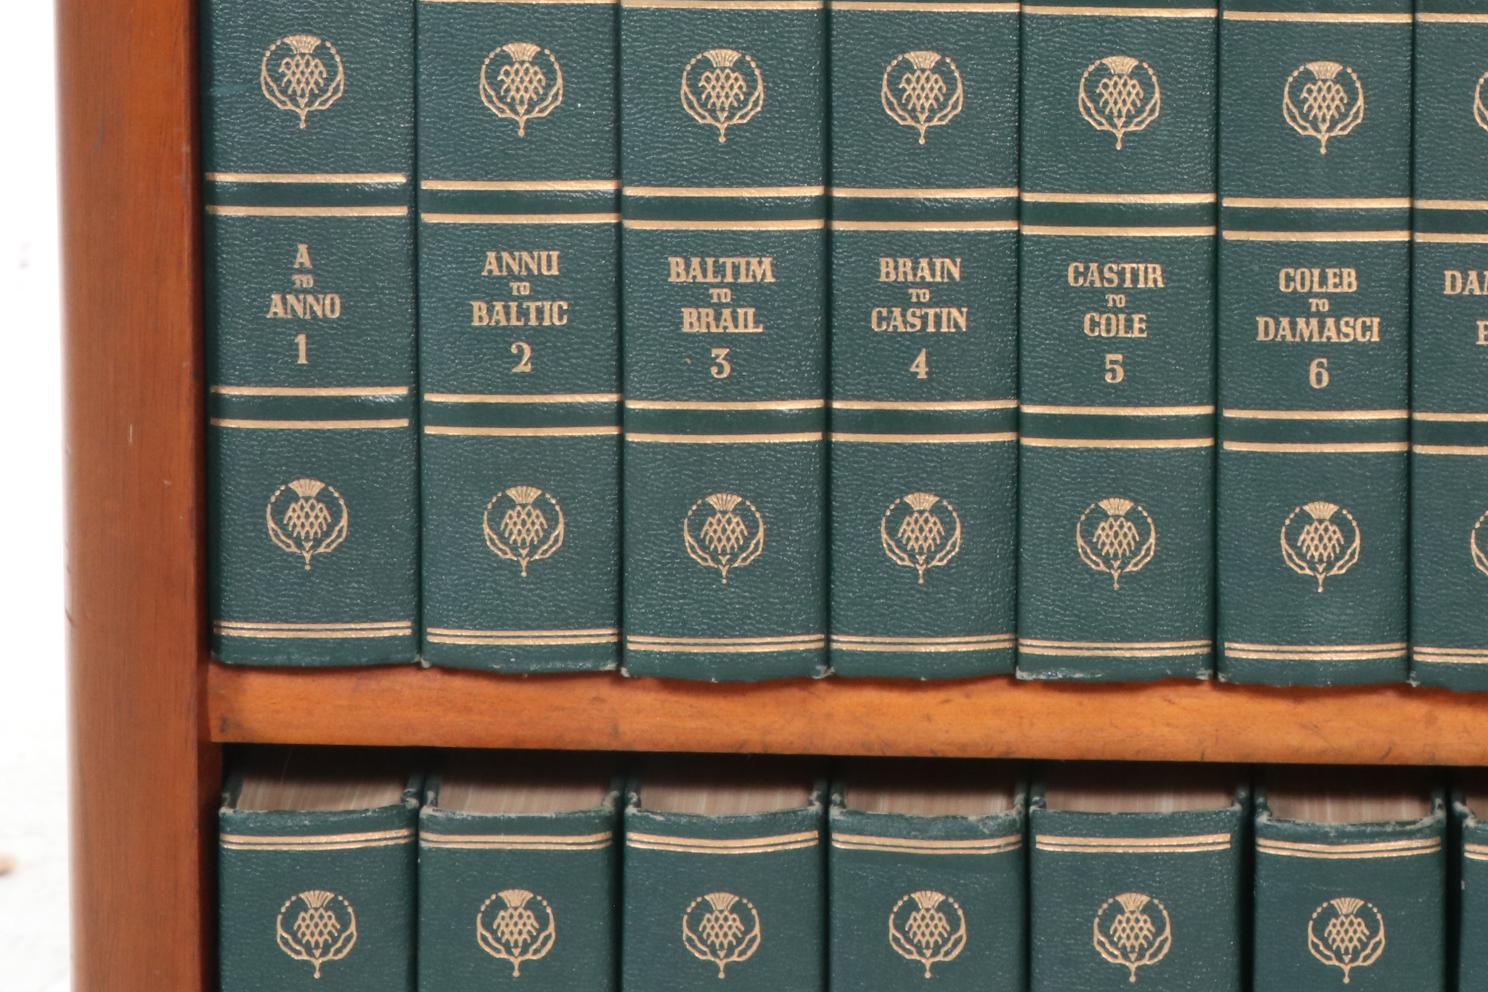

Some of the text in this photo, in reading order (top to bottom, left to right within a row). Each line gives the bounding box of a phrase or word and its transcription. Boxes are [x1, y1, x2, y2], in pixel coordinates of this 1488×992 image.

[293, 243, 312, 269] A
[481, 249, 561, 277] ANNU
[668, 255, 776, 284] BALTIM
[879, 255, 962, 283] BRAIN
[292, 273, 315, 289] TO
[510, 280, 532, 296] TO
[1067, 261, 1166, 289] CASTIR
[1279, 266, 1359, 294] COLEB
[267, 292, 342, 320] ANNO
[710, 287, 734, 304] TO
[907, 287, 931, 303] TO
[1106, 292, 1127, 308] TO
[1309, 297, 1331, 313] TO
[470, 299, 569, 327] BALTIC
[680, 305, 766, 334] BRAIL
[870, 306, 969, 333] CASTIN
[1083, 311, 1148, 338] COLE
[1255, 315, 1381, 343] DAMASCI
[295, 333, 308, 365] 1
[511, 341, 533, 373] 2
[709, 347, 732, 379] 3
[911, 349, 929, 380] 4
[1104, 353, 1125, 384] 5
[1308, 357, 1331, 389] 6
